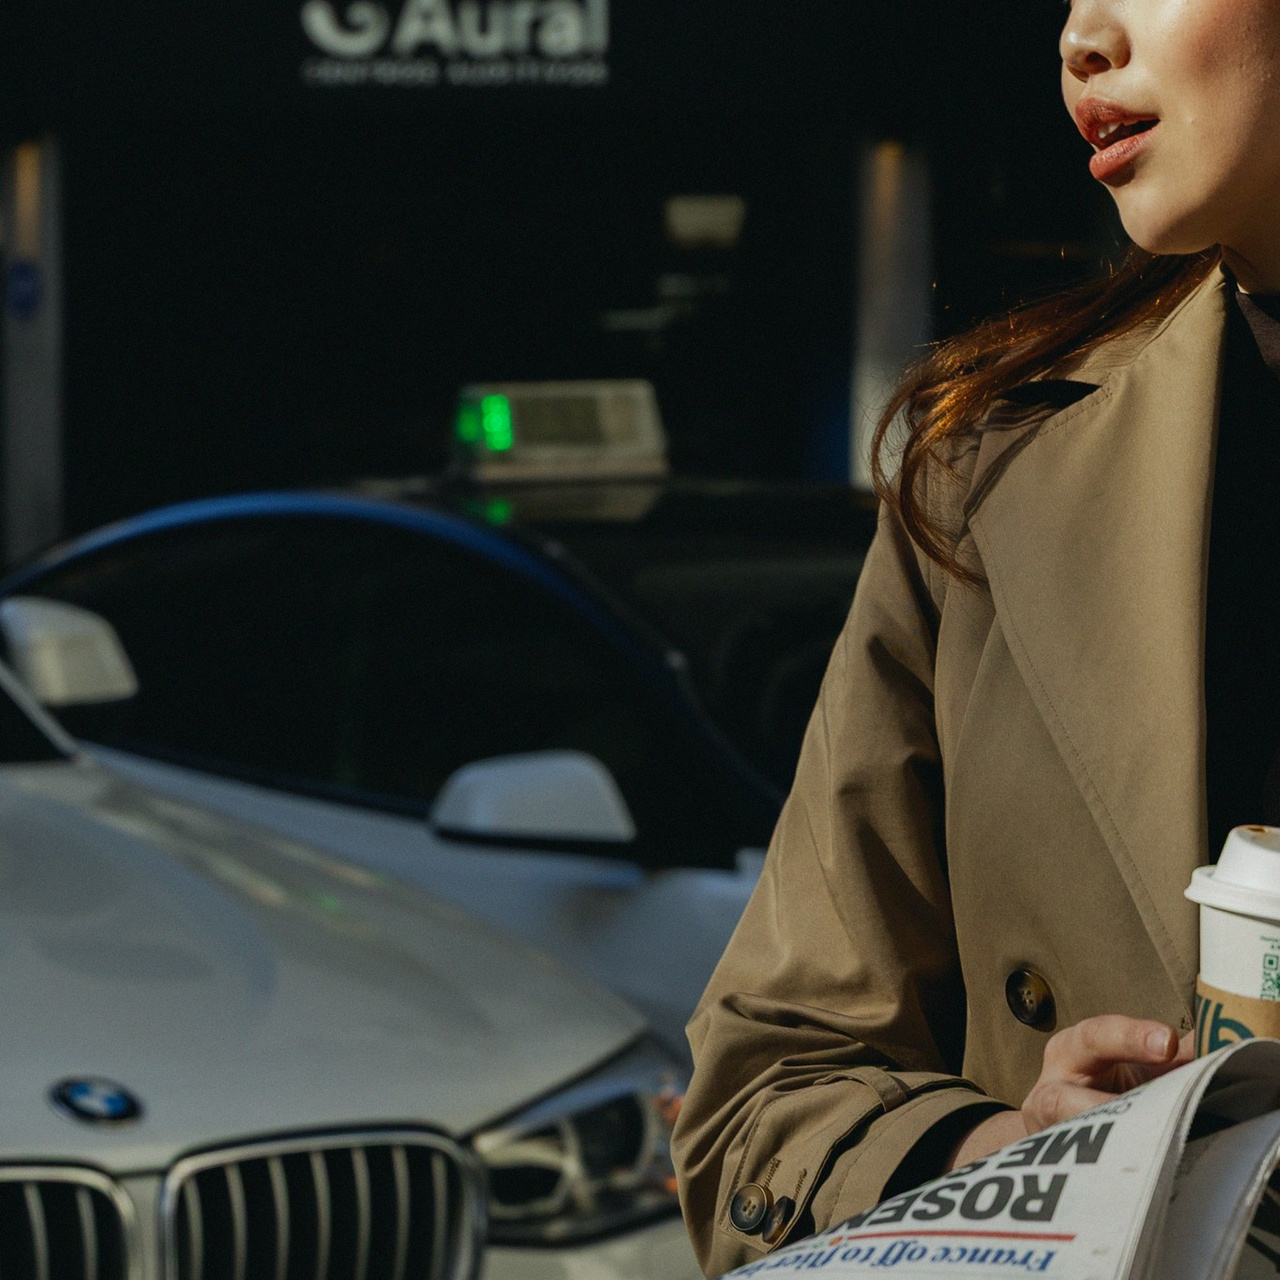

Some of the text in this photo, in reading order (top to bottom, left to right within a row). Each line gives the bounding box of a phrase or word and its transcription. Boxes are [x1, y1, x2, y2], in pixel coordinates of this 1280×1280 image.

[840, 1244, 872, 1264] to
[871, 1238, 928, 1269] off
[941, 1246, 1056, 1271] France
